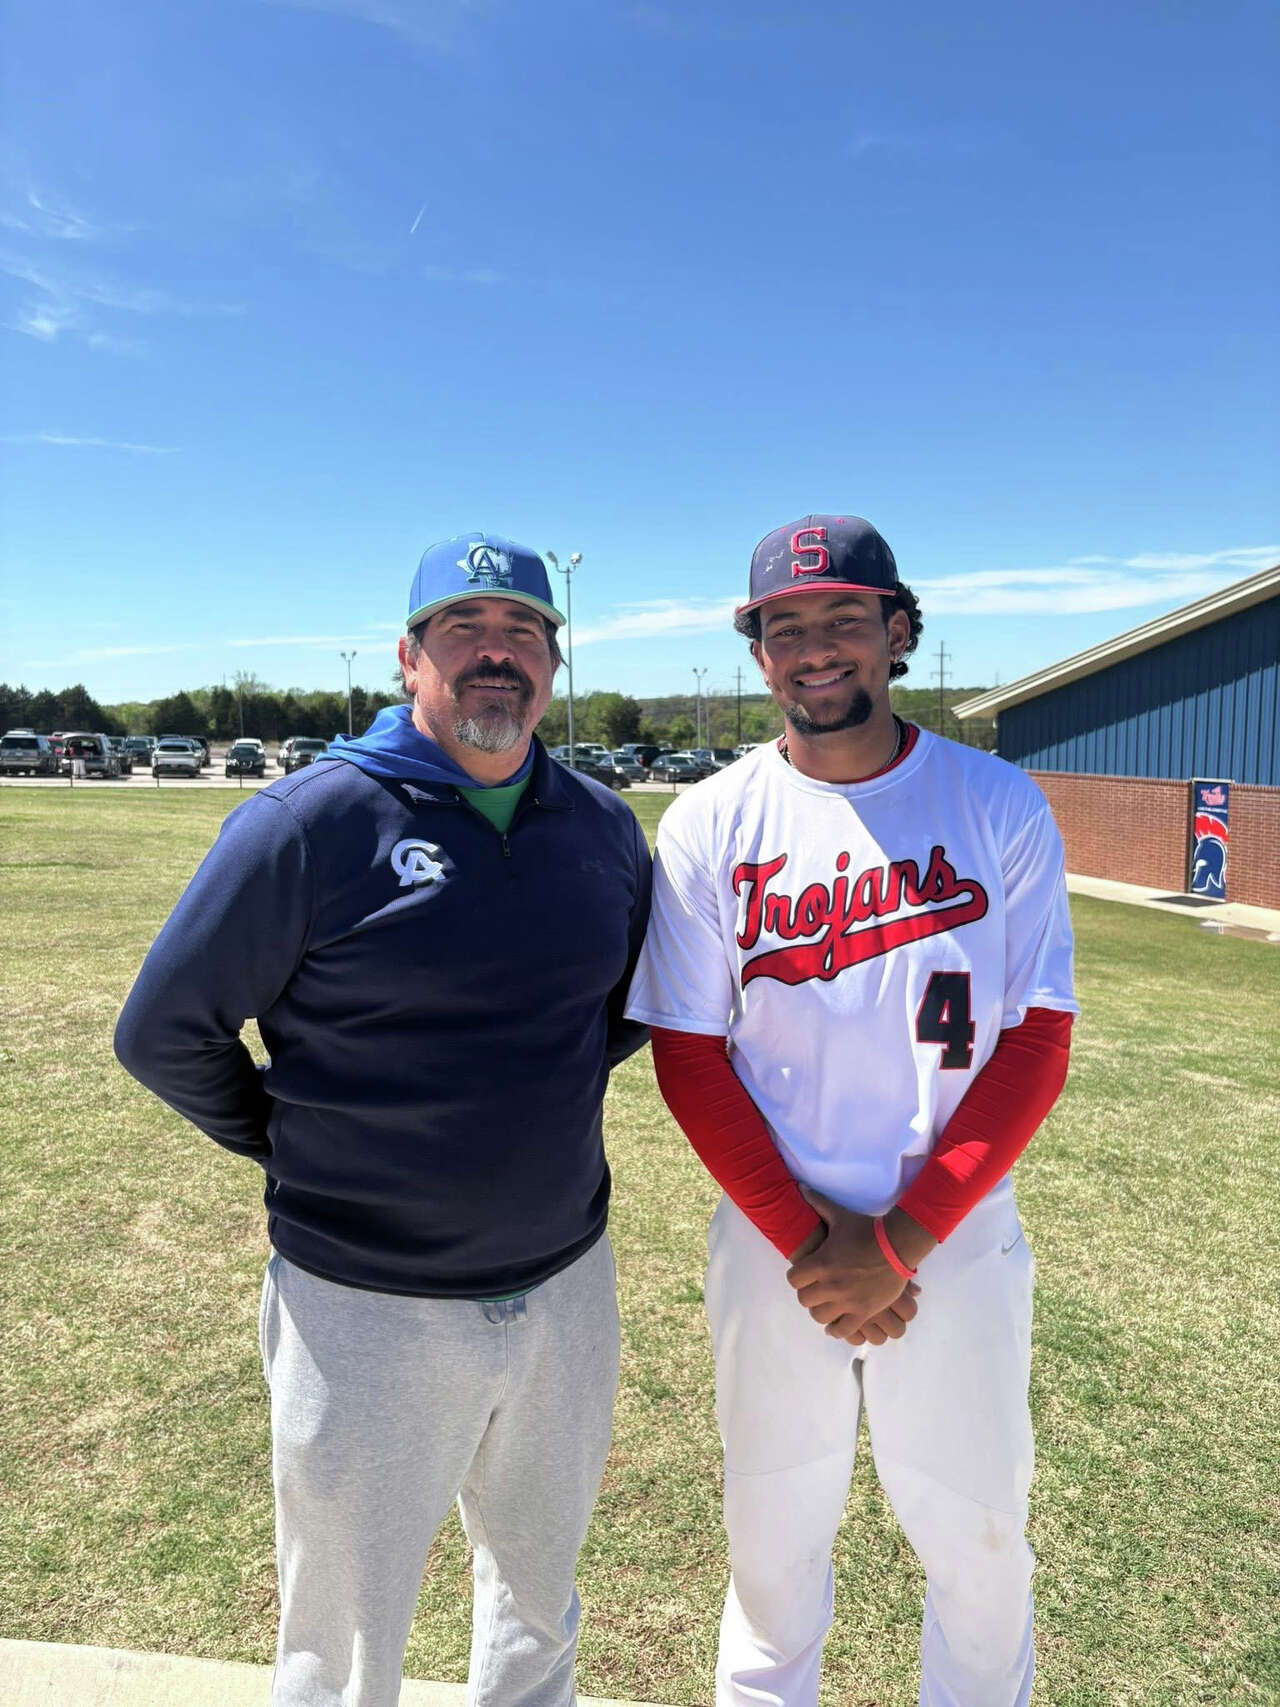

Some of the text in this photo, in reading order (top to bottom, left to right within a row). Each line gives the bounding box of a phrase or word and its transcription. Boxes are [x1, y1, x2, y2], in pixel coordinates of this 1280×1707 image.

[791, 527, 829, 578] S
[733, 845, 989, 982] Trojans
[916, 971, 976, 1070] 4
